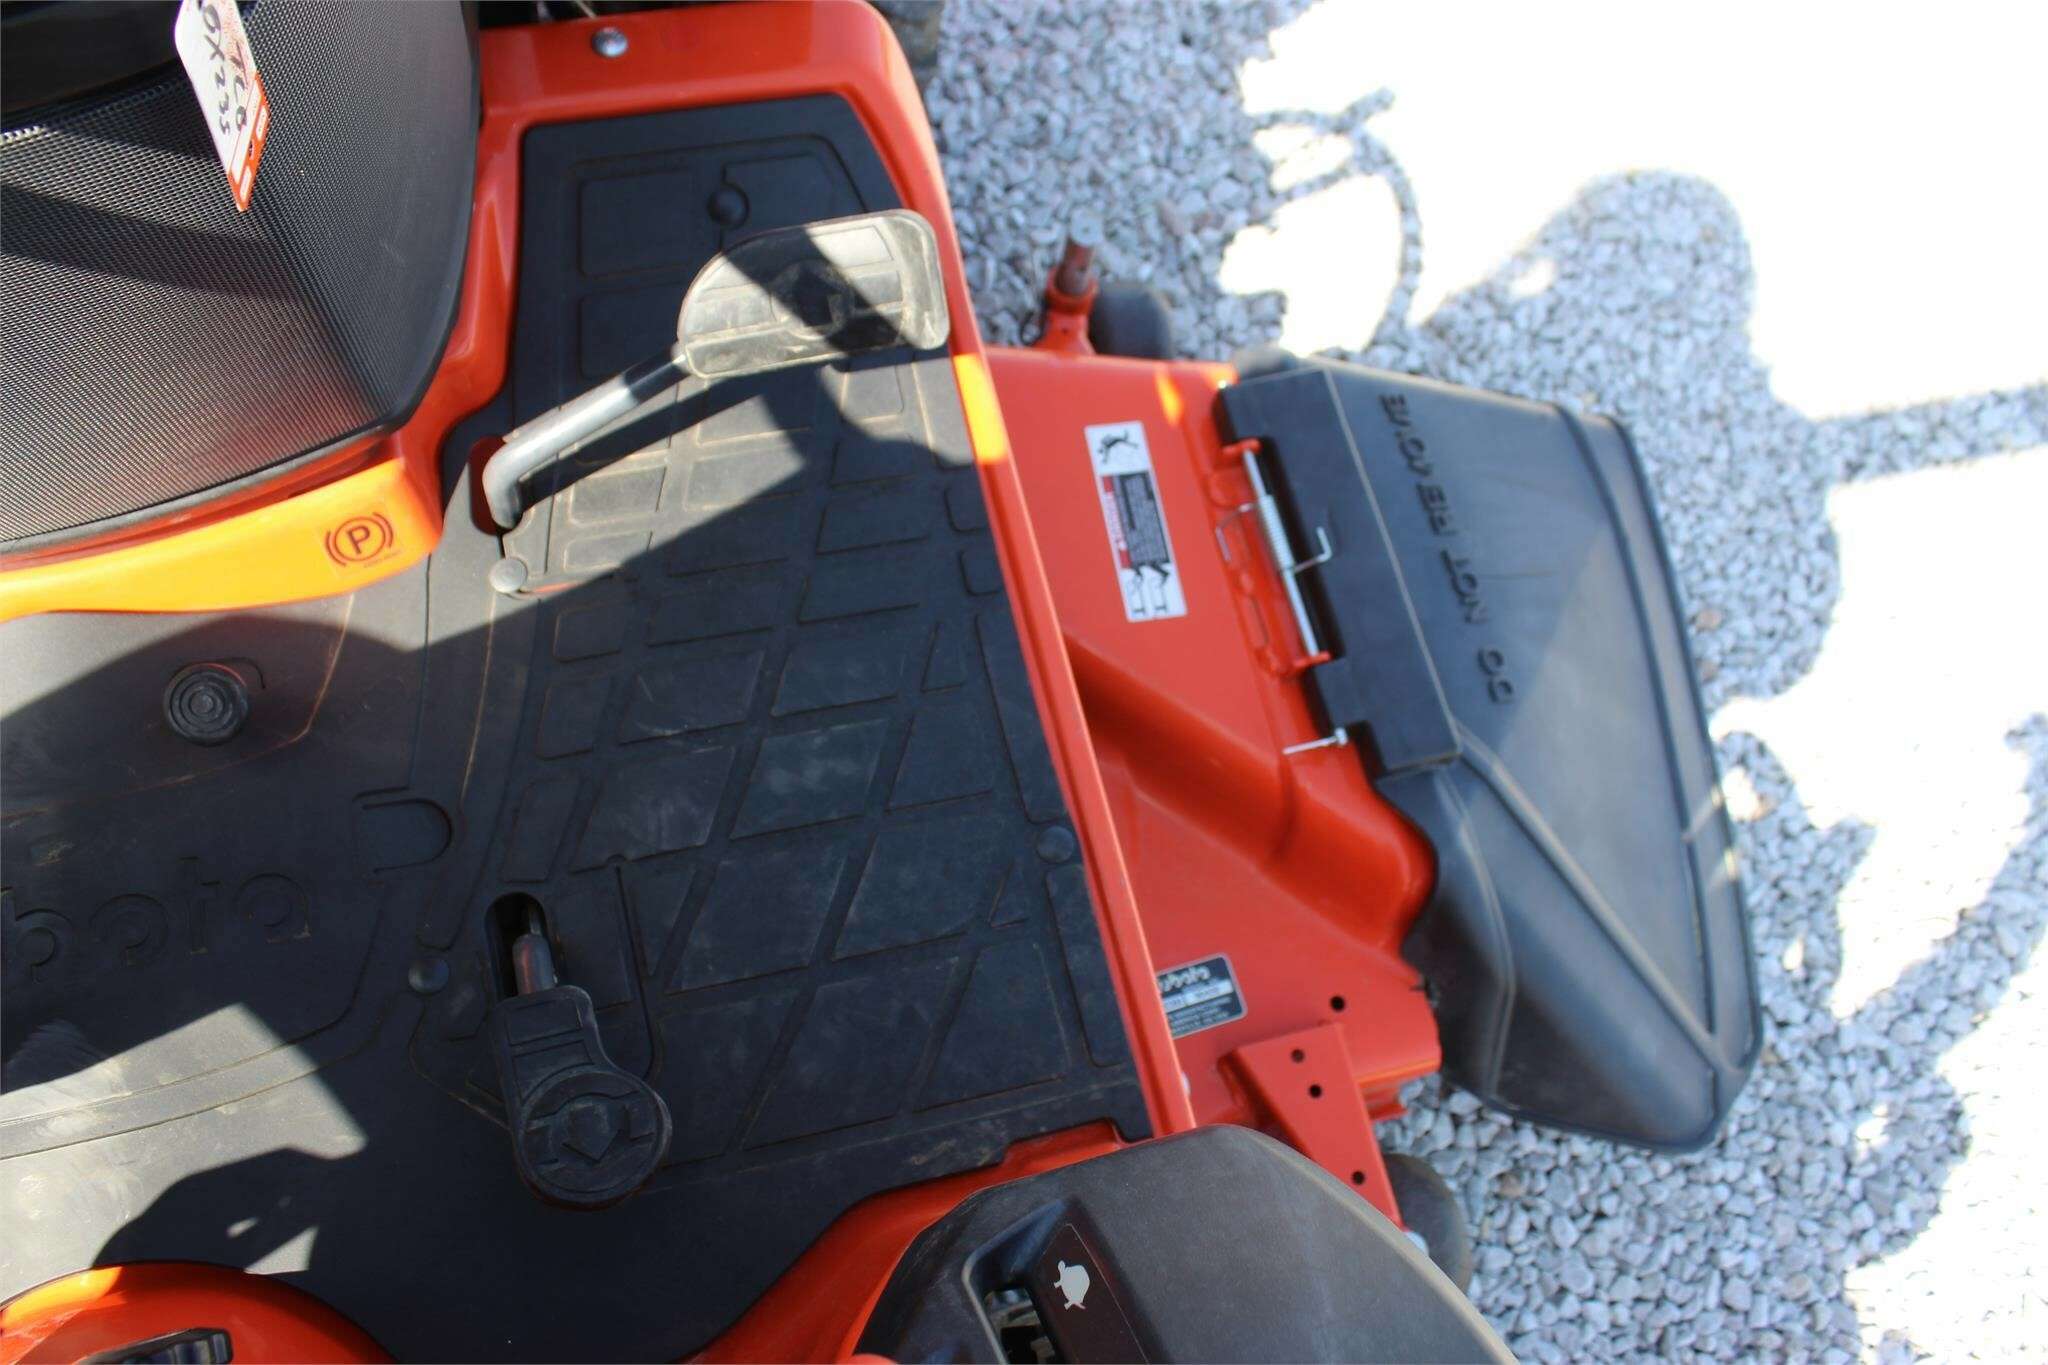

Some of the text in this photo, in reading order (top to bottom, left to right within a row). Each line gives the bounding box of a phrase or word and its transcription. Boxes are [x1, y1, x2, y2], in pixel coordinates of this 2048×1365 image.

[346, 526, 371, 555] P
[1378, 394, 1514, 705] DO NOT REMOVE
